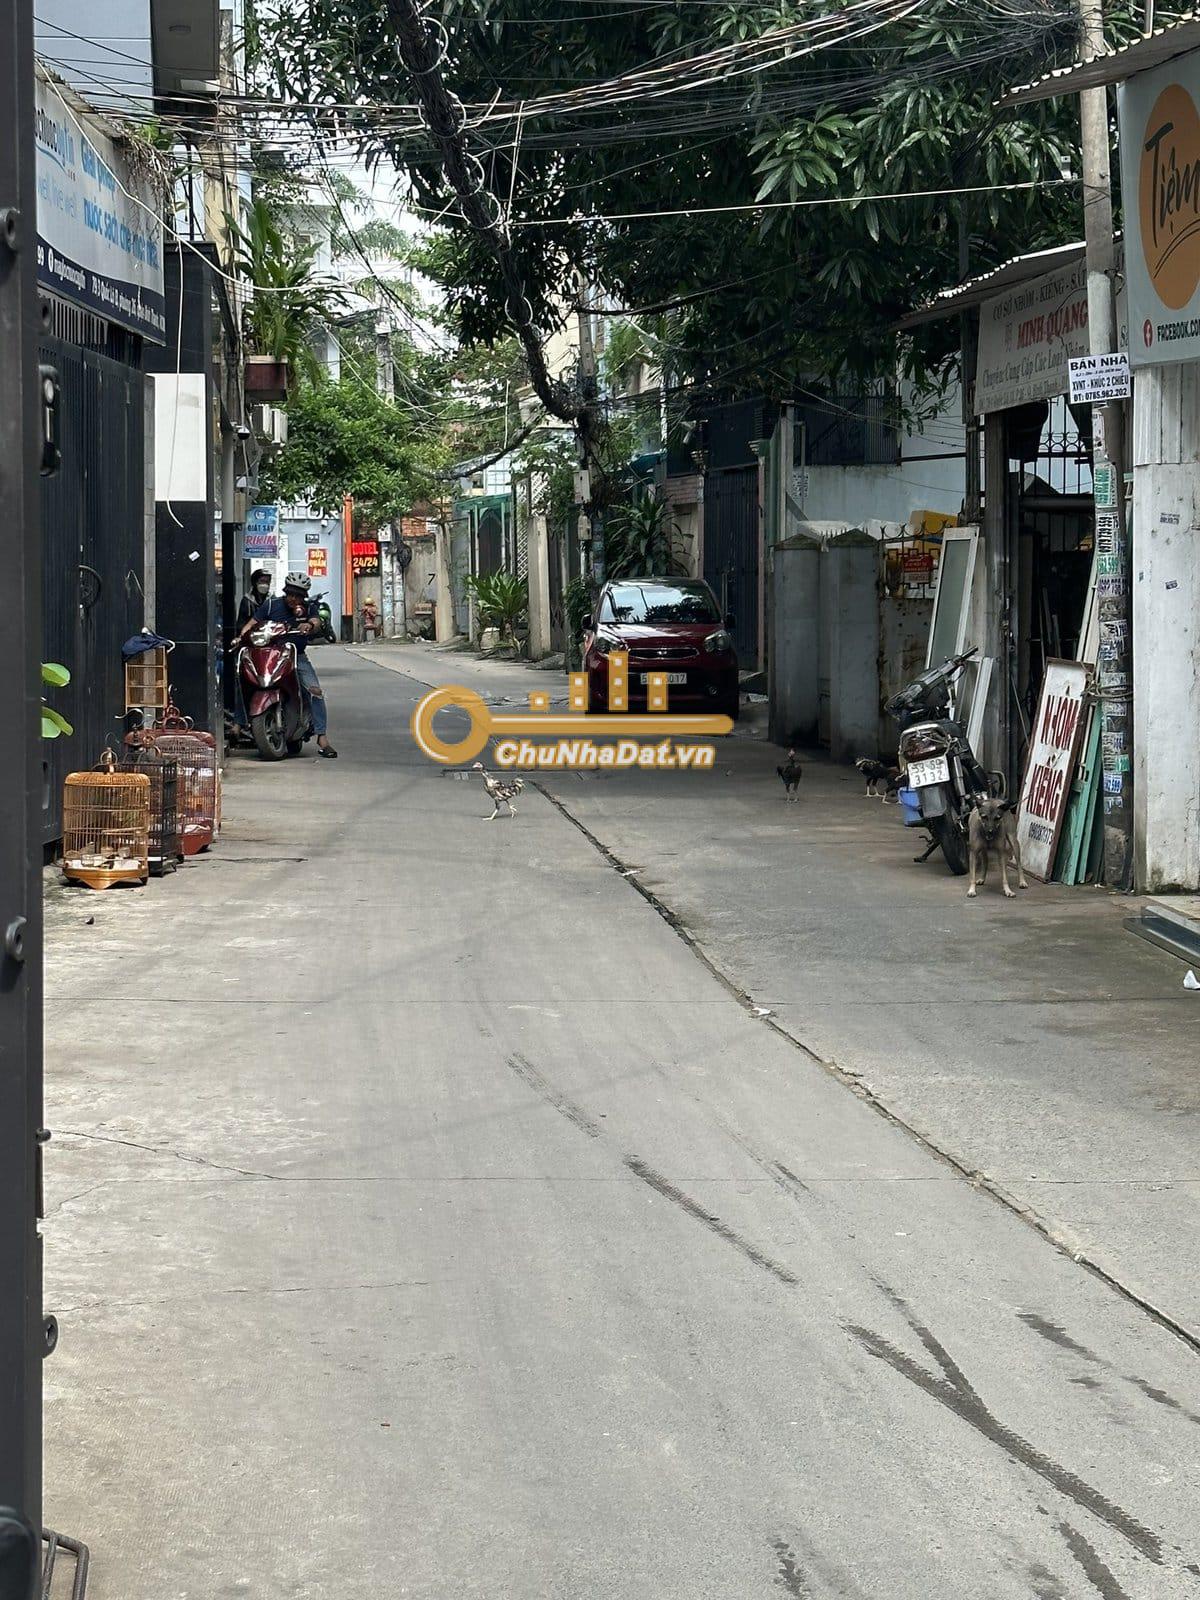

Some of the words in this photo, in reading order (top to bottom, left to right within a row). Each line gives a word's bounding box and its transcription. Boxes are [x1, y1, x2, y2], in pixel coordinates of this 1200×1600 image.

[1017, 312, 1045, 350] MINH
[1046, 300, 1088, 345] QUANG
[1157, 318, 1200, 342] FACEBOOK.CO
[1070, 358, 1096, 371] BÁN
[352, 542, 379, 555] HOTEL
[352, 557, 379, 568] 24/24
[915, 769, 943, 785] 3132
